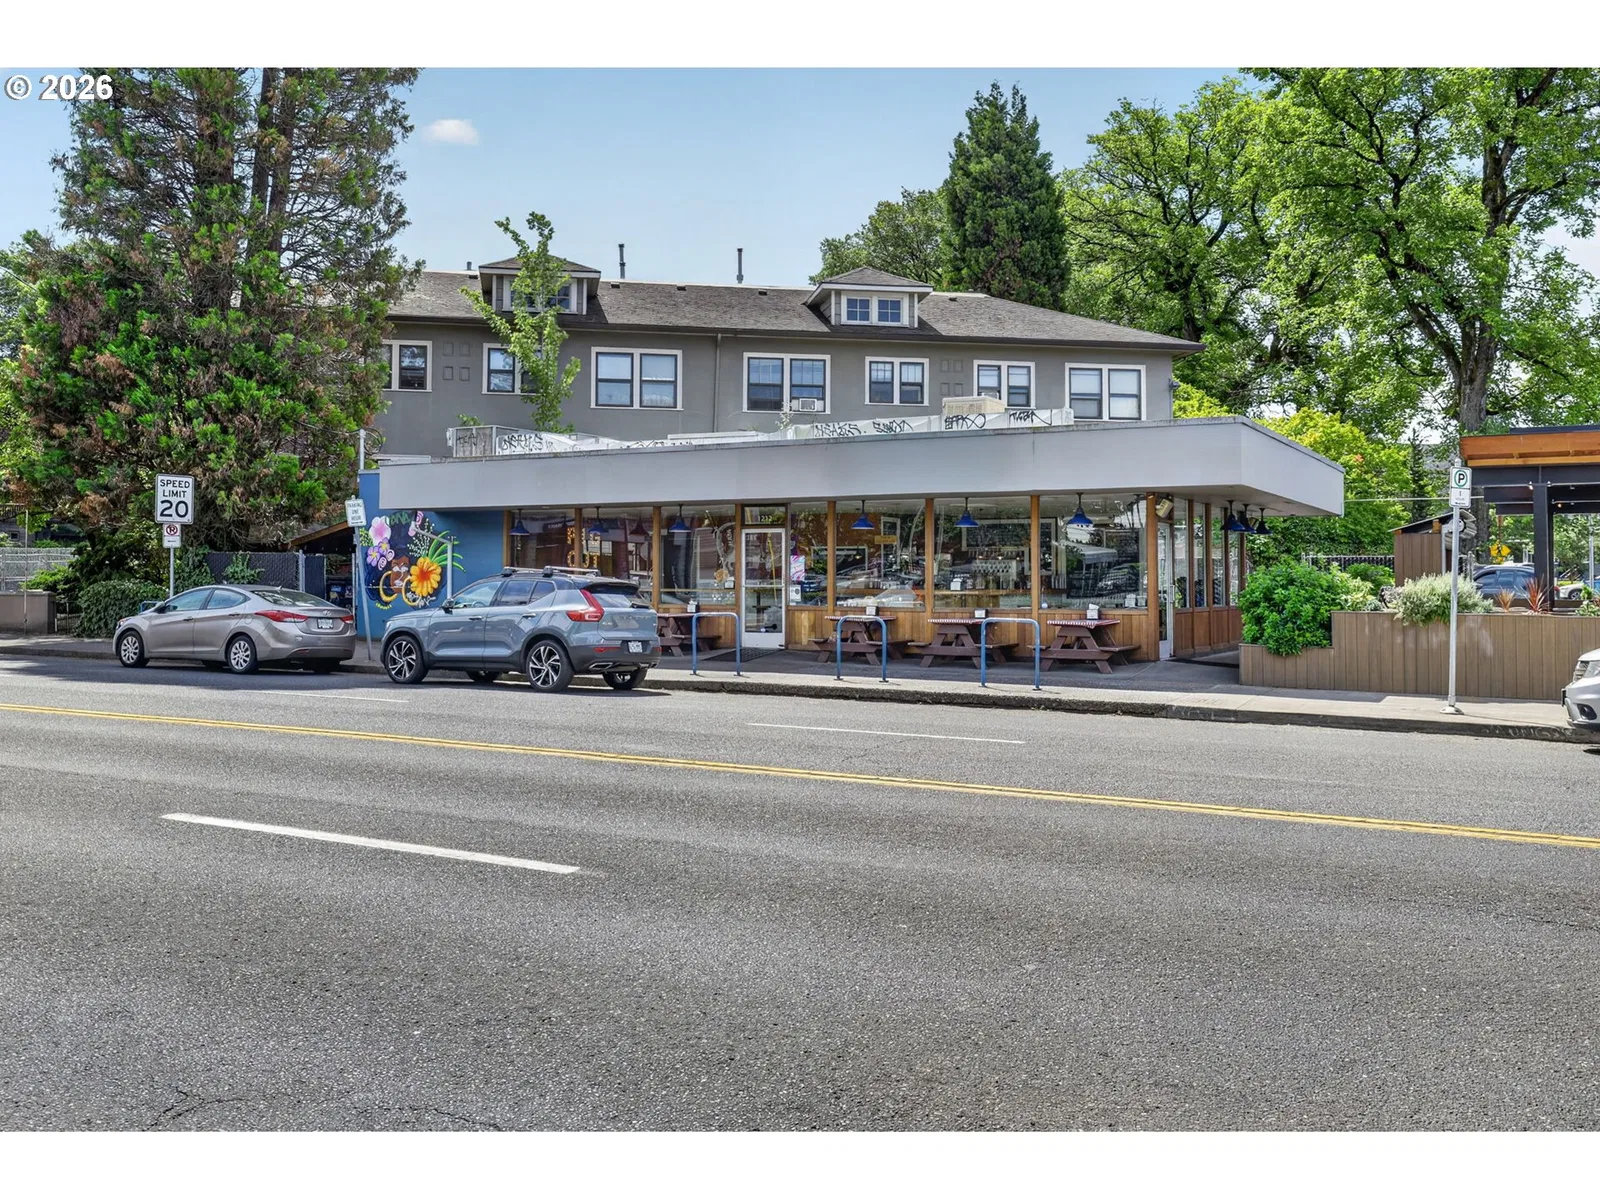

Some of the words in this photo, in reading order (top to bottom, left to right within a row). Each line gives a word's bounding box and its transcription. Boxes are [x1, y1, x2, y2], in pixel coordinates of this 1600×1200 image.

[160, 479, 190, 488] SPEED
[1458, 473, 1465, 484] P
[162, 489, 187, 498] LIMIT
[159, 499, 189, 518] 20
